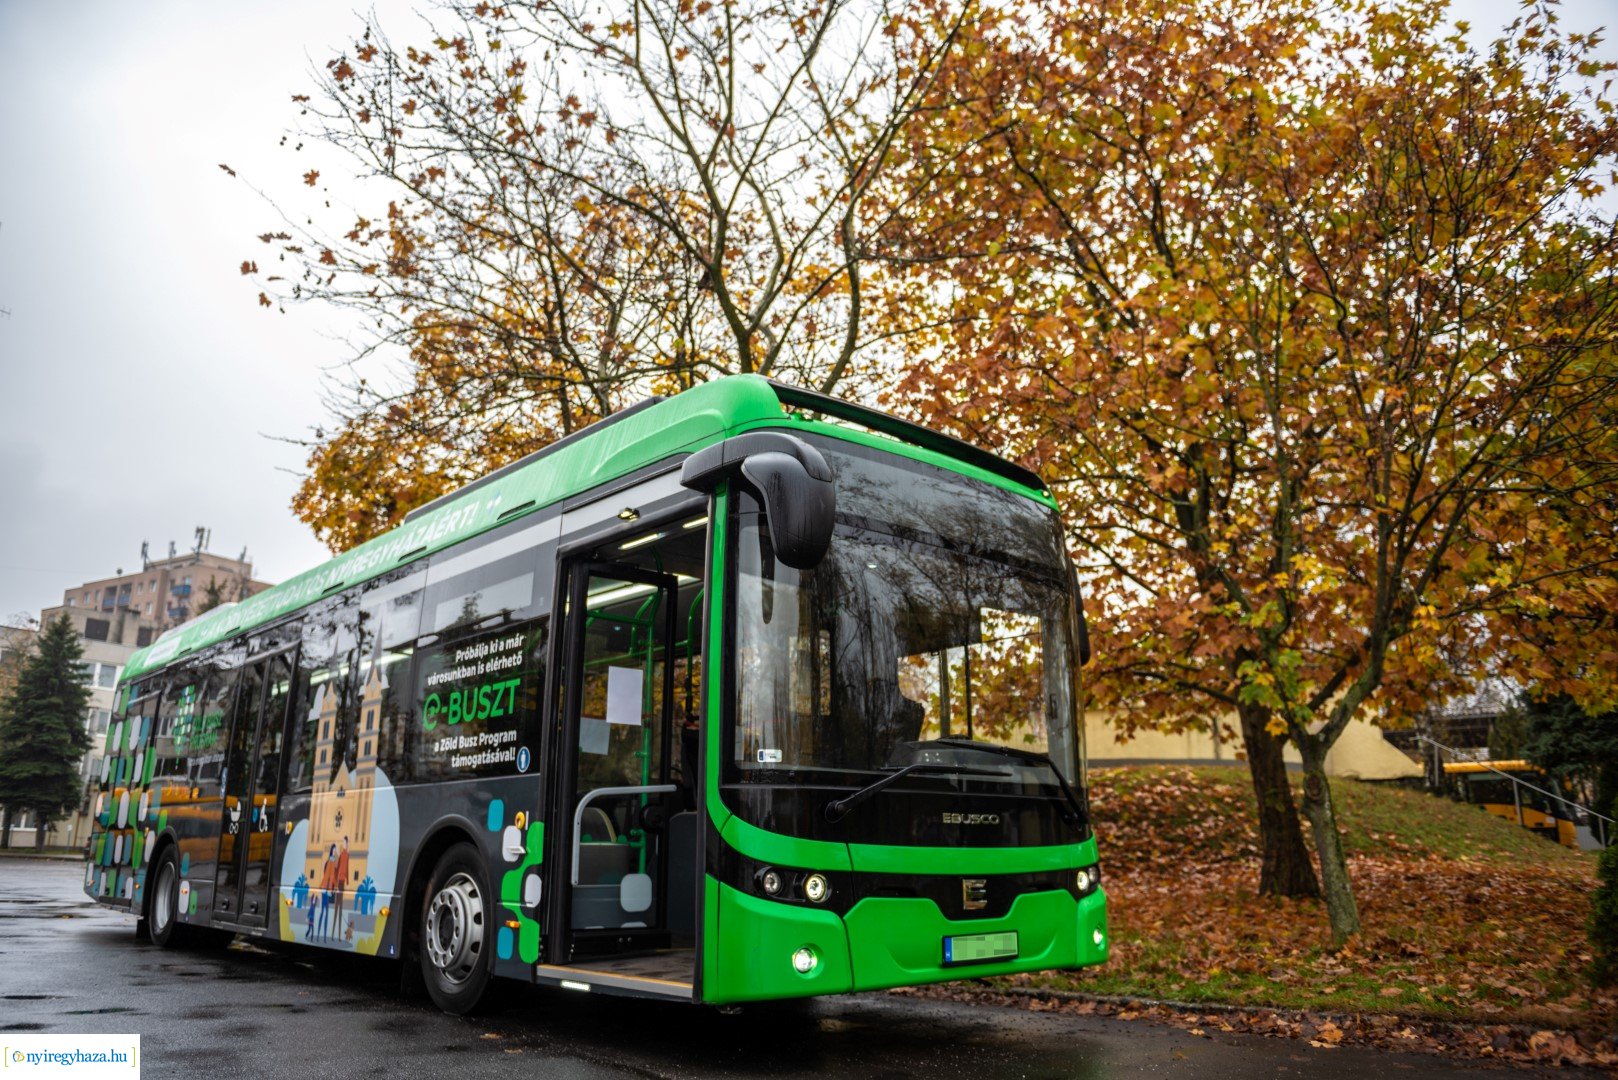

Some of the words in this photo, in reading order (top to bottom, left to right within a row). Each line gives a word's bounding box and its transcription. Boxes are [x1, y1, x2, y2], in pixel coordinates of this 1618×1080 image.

[455, 643, 489, 663] Próbálja
[489, 641, 499, 655] ki
[499, 642, 504, 651] a
[505, 633, 524, 650] már
[427, 666, 476, 686] városunkban
[477, 661, 485, 674] is
[485, 650, 523, 673] elérhető
[434, 741, 439, 752] a
[440, 734, 458, 752] Zöld
[459, 735, 478, 749] Busz
[479, 730, 517, 747] Program
[451, 747, 516, 769] támogatásával!
[942, 812, 1000, 825] EBUSCO
